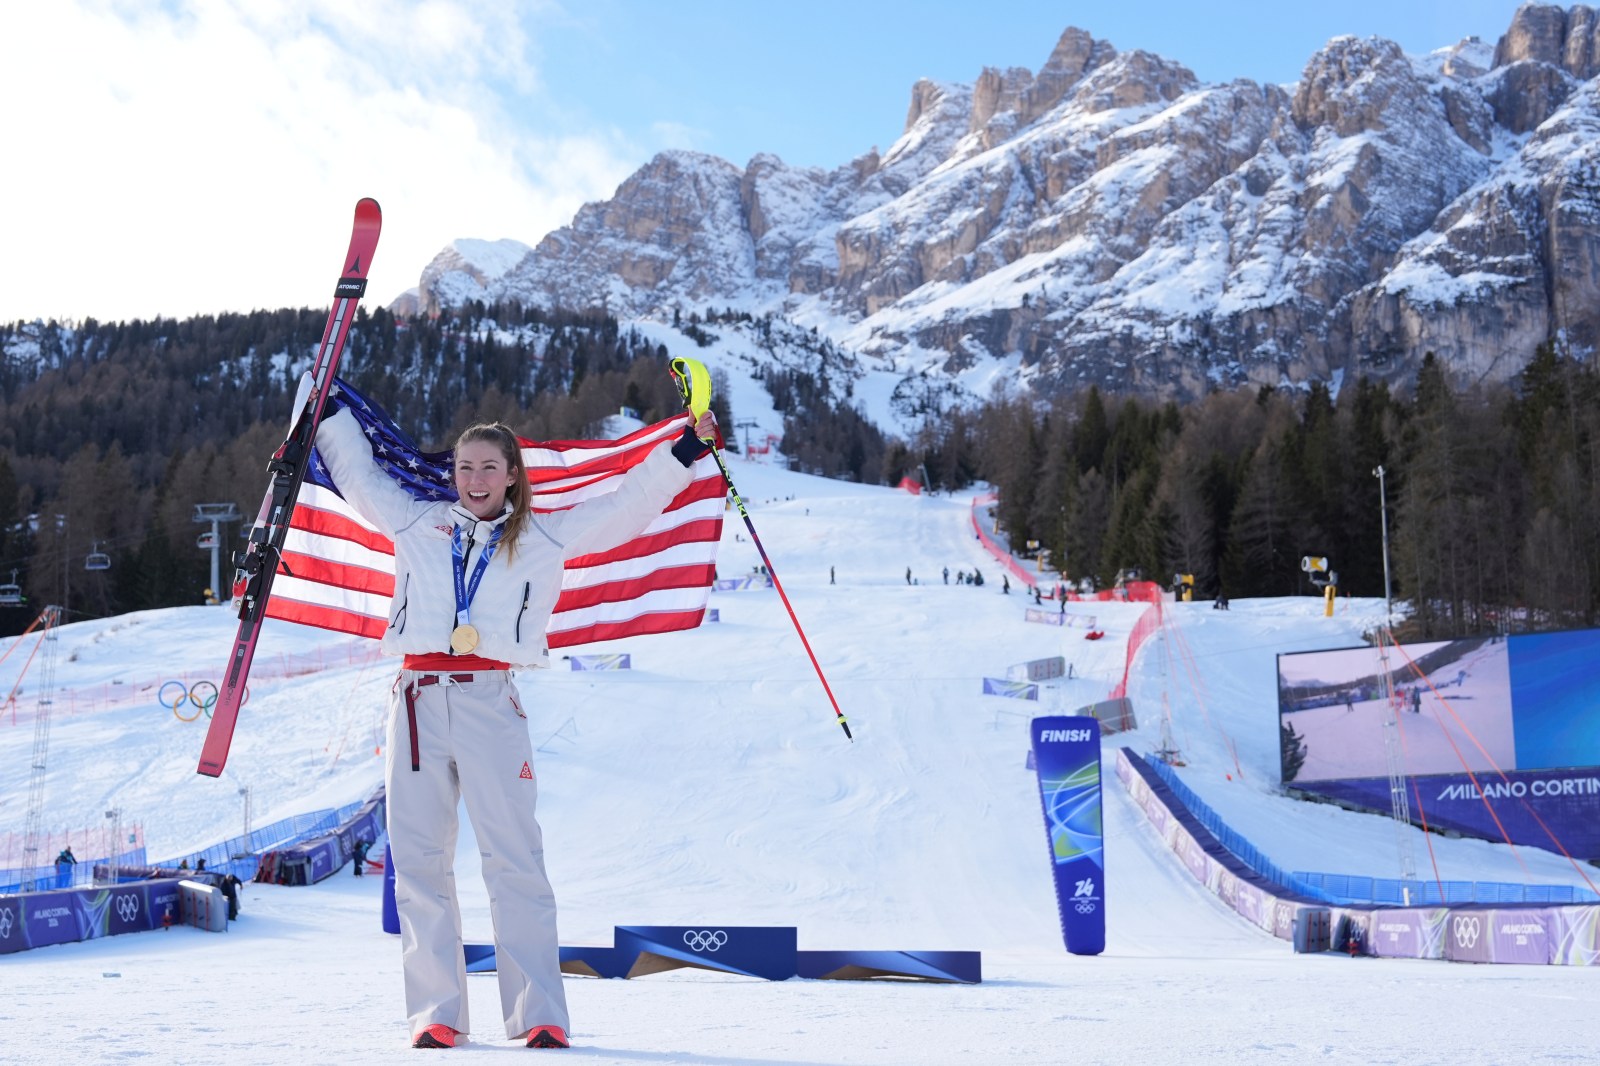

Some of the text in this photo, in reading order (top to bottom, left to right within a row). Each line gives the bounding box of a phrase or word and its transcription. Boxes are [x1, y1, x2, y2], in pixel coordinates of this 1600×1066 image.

[729, 486, 748, 518] LEKI
[1040, 729, 1091, 743] FINISH
[1436, 781, 1527, 800] MILANO
